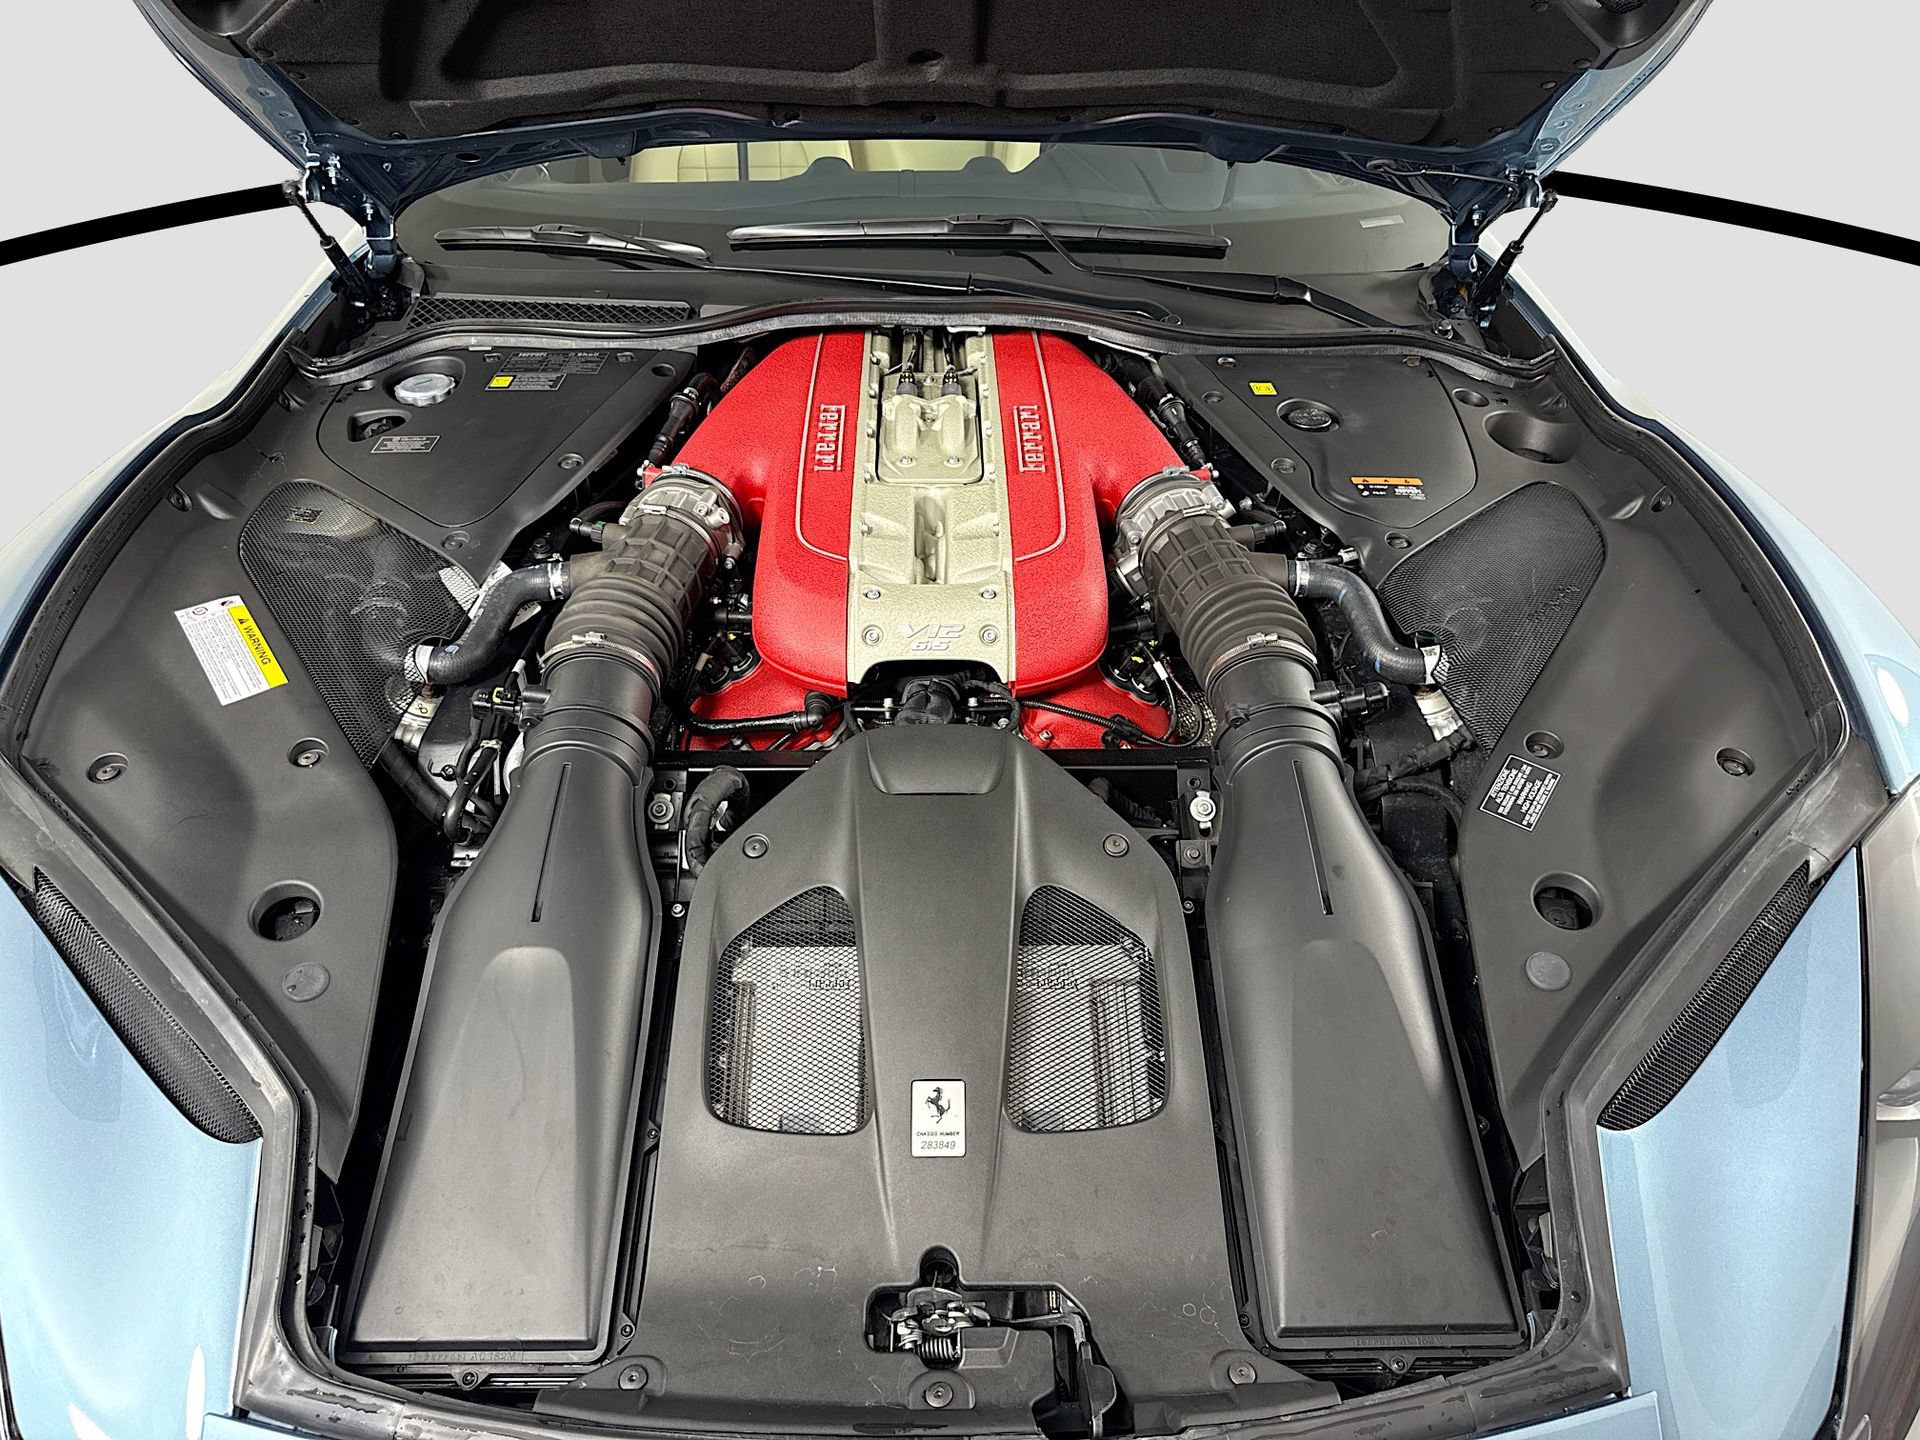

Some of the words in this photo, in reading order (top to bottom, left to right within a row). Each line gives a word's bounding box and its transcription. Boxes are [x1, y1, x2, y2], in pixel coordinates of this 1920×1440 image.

[813, 403, 846, 472] Ferrari
[1013, 405, 1046, 473] Ferrari
[243, 623, 272, 666] WARNING
[898, 622, 965, 639] V12
[1516, 782, 1533, 804] WARNING
[1520, 800, 1531, 813] HIGH
[1527, 779, 1542, 800] VOLTAGE
[920, 1139, 957, 1150] 283849
